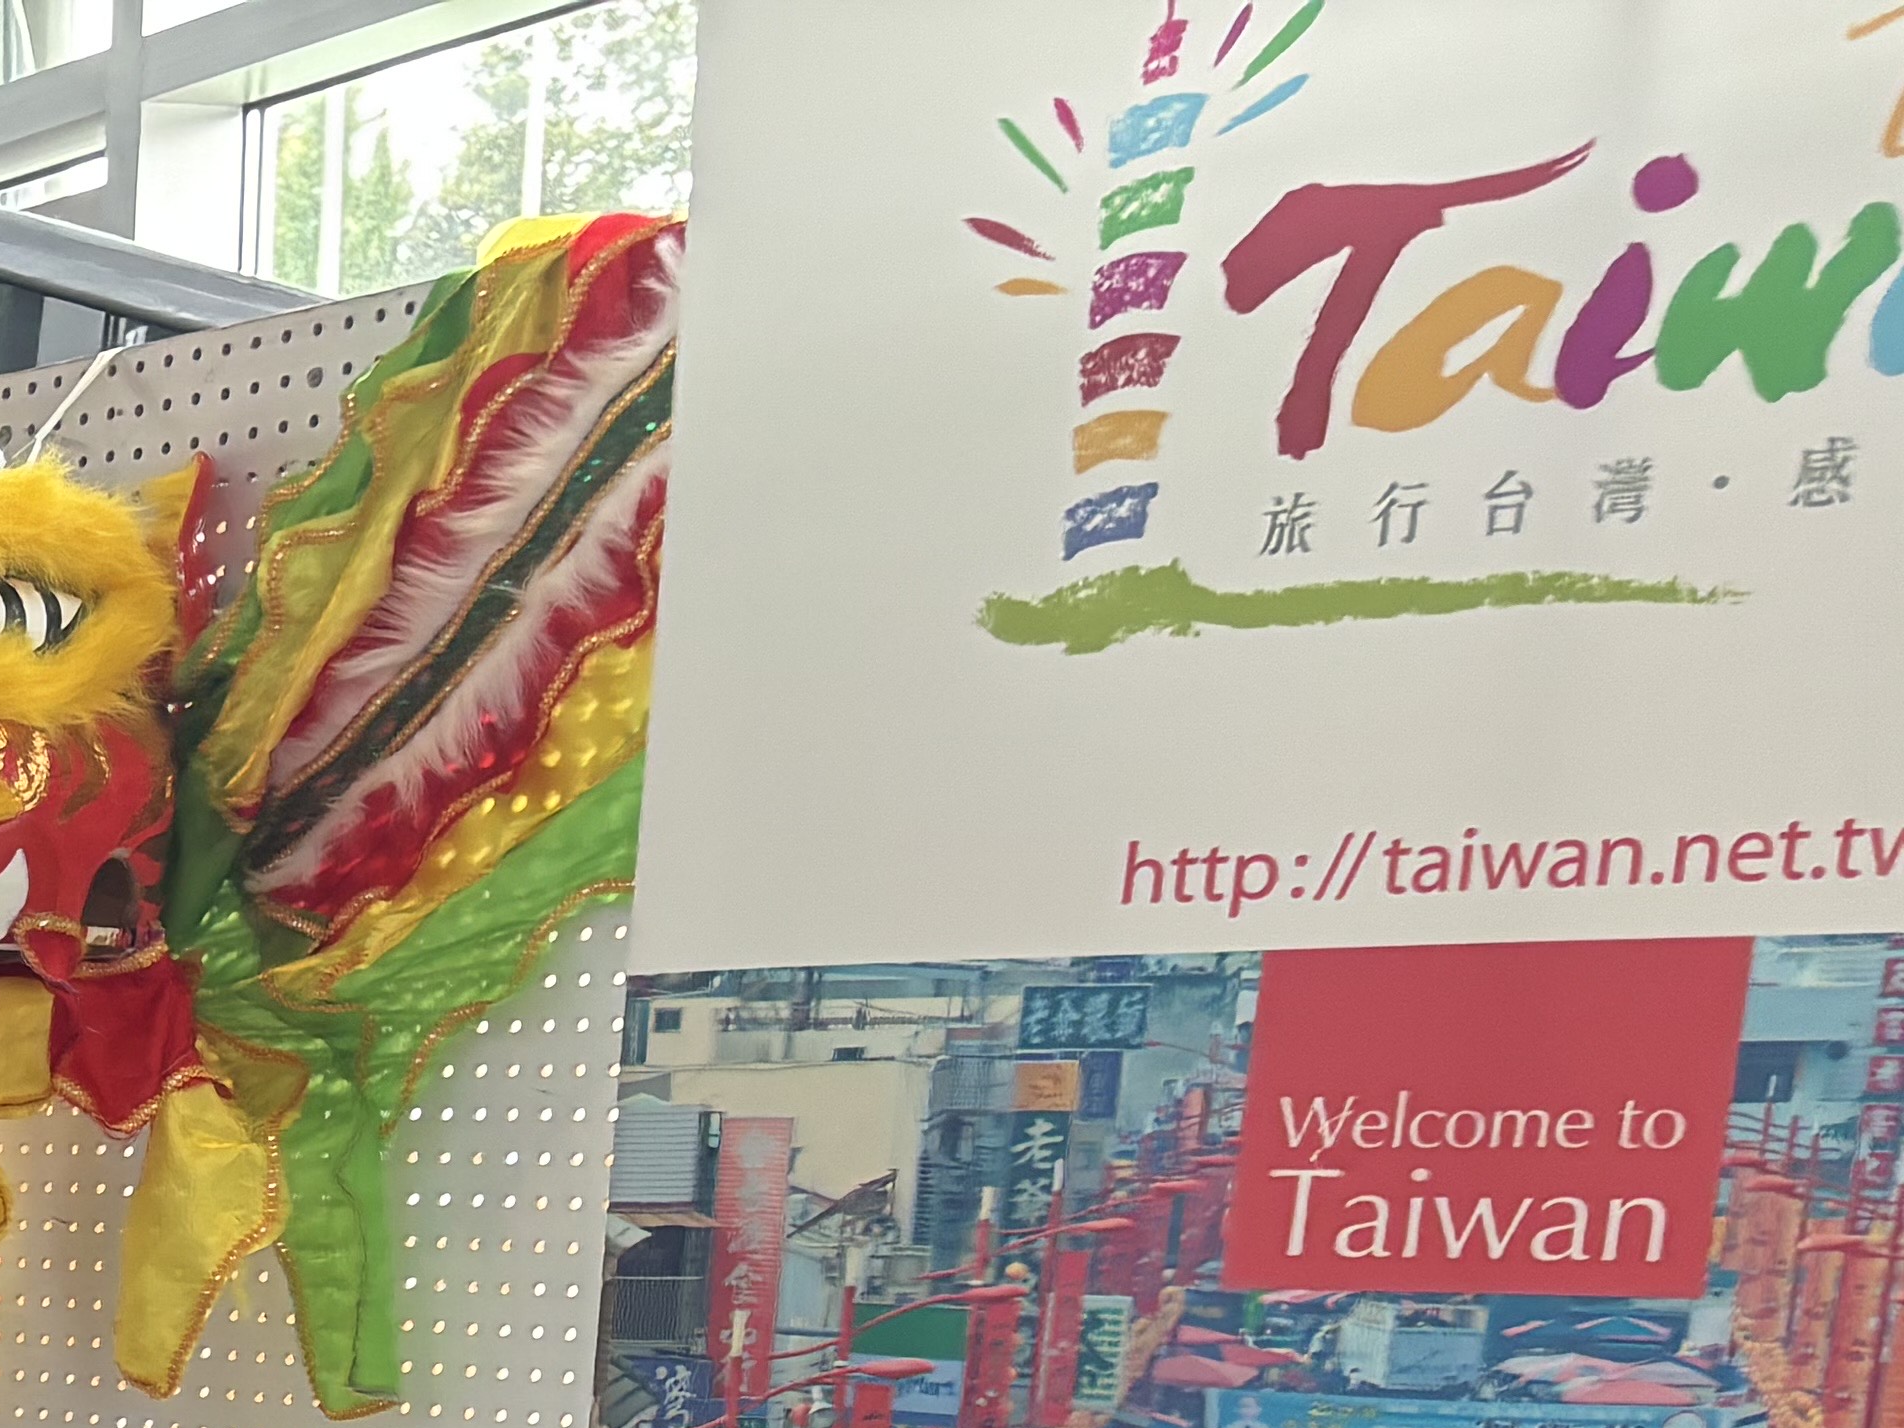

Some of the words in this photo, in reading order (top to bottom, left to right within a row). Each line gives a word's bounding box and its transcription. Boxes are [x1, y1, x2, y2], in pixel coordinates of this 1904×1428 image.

[1279, 1096, 1595, 1154] Welcome
[1617, 1098, 1688, 1151] to
[1268, 1167, 1666, 1265] Taiwan
